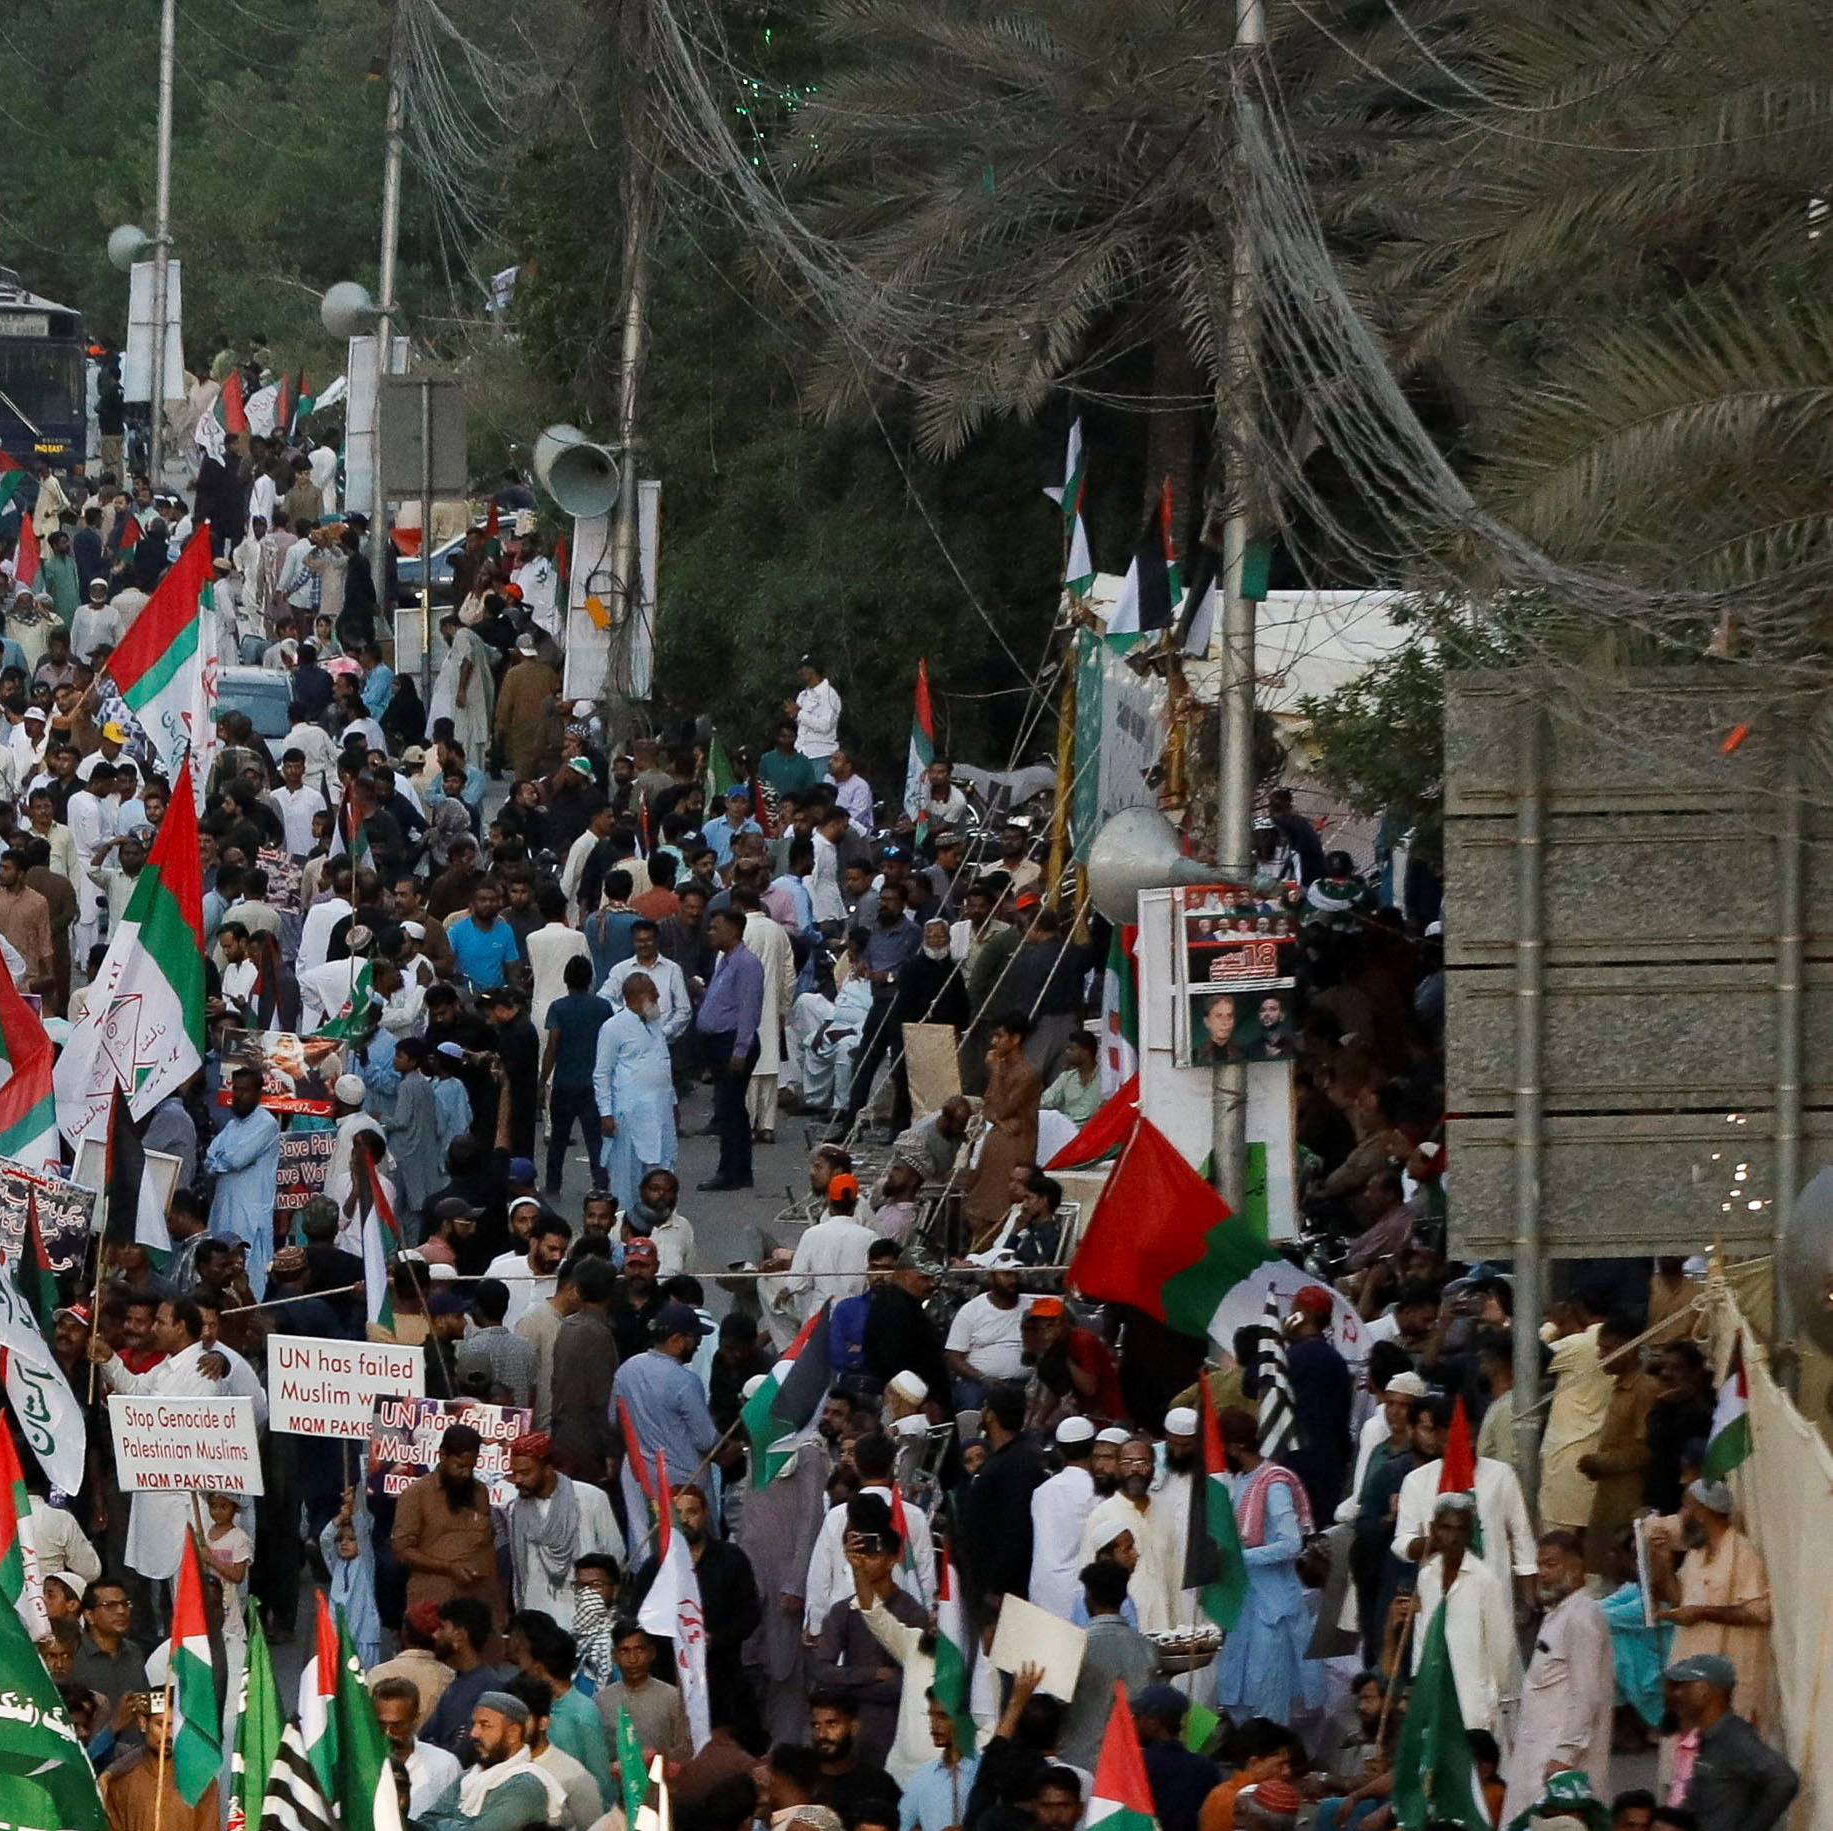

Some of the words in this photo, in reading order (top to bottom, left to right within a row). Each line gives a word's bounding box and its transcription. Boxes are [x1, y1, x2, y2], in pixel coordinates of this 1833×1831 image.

[279, 1347, 310, 1369] UN
[318, 1355, 352, 1375] has
[358, 1352, 413, 1379] failed
[281, 1380, 350, 1405] Muslim
[125, 1406, 153, 1430] Stop
[158, 1407, 220, 1430] Genocide
[223, 1408, 237, 1429] of
[289, 1416, 325, 1434] MQM
[381, 1401, 416, 1430] UN
[123, 1438, 192, 1460] Palestinian
[196, 1441, 248, 1461] Muslims
[378, 1435, 439, 1466] Musli
[474, 1446, 512, 1473] orld
[136, 1473, 171, 1489] MQM
[174, 1474, 244, 1491] PAKISTAN
